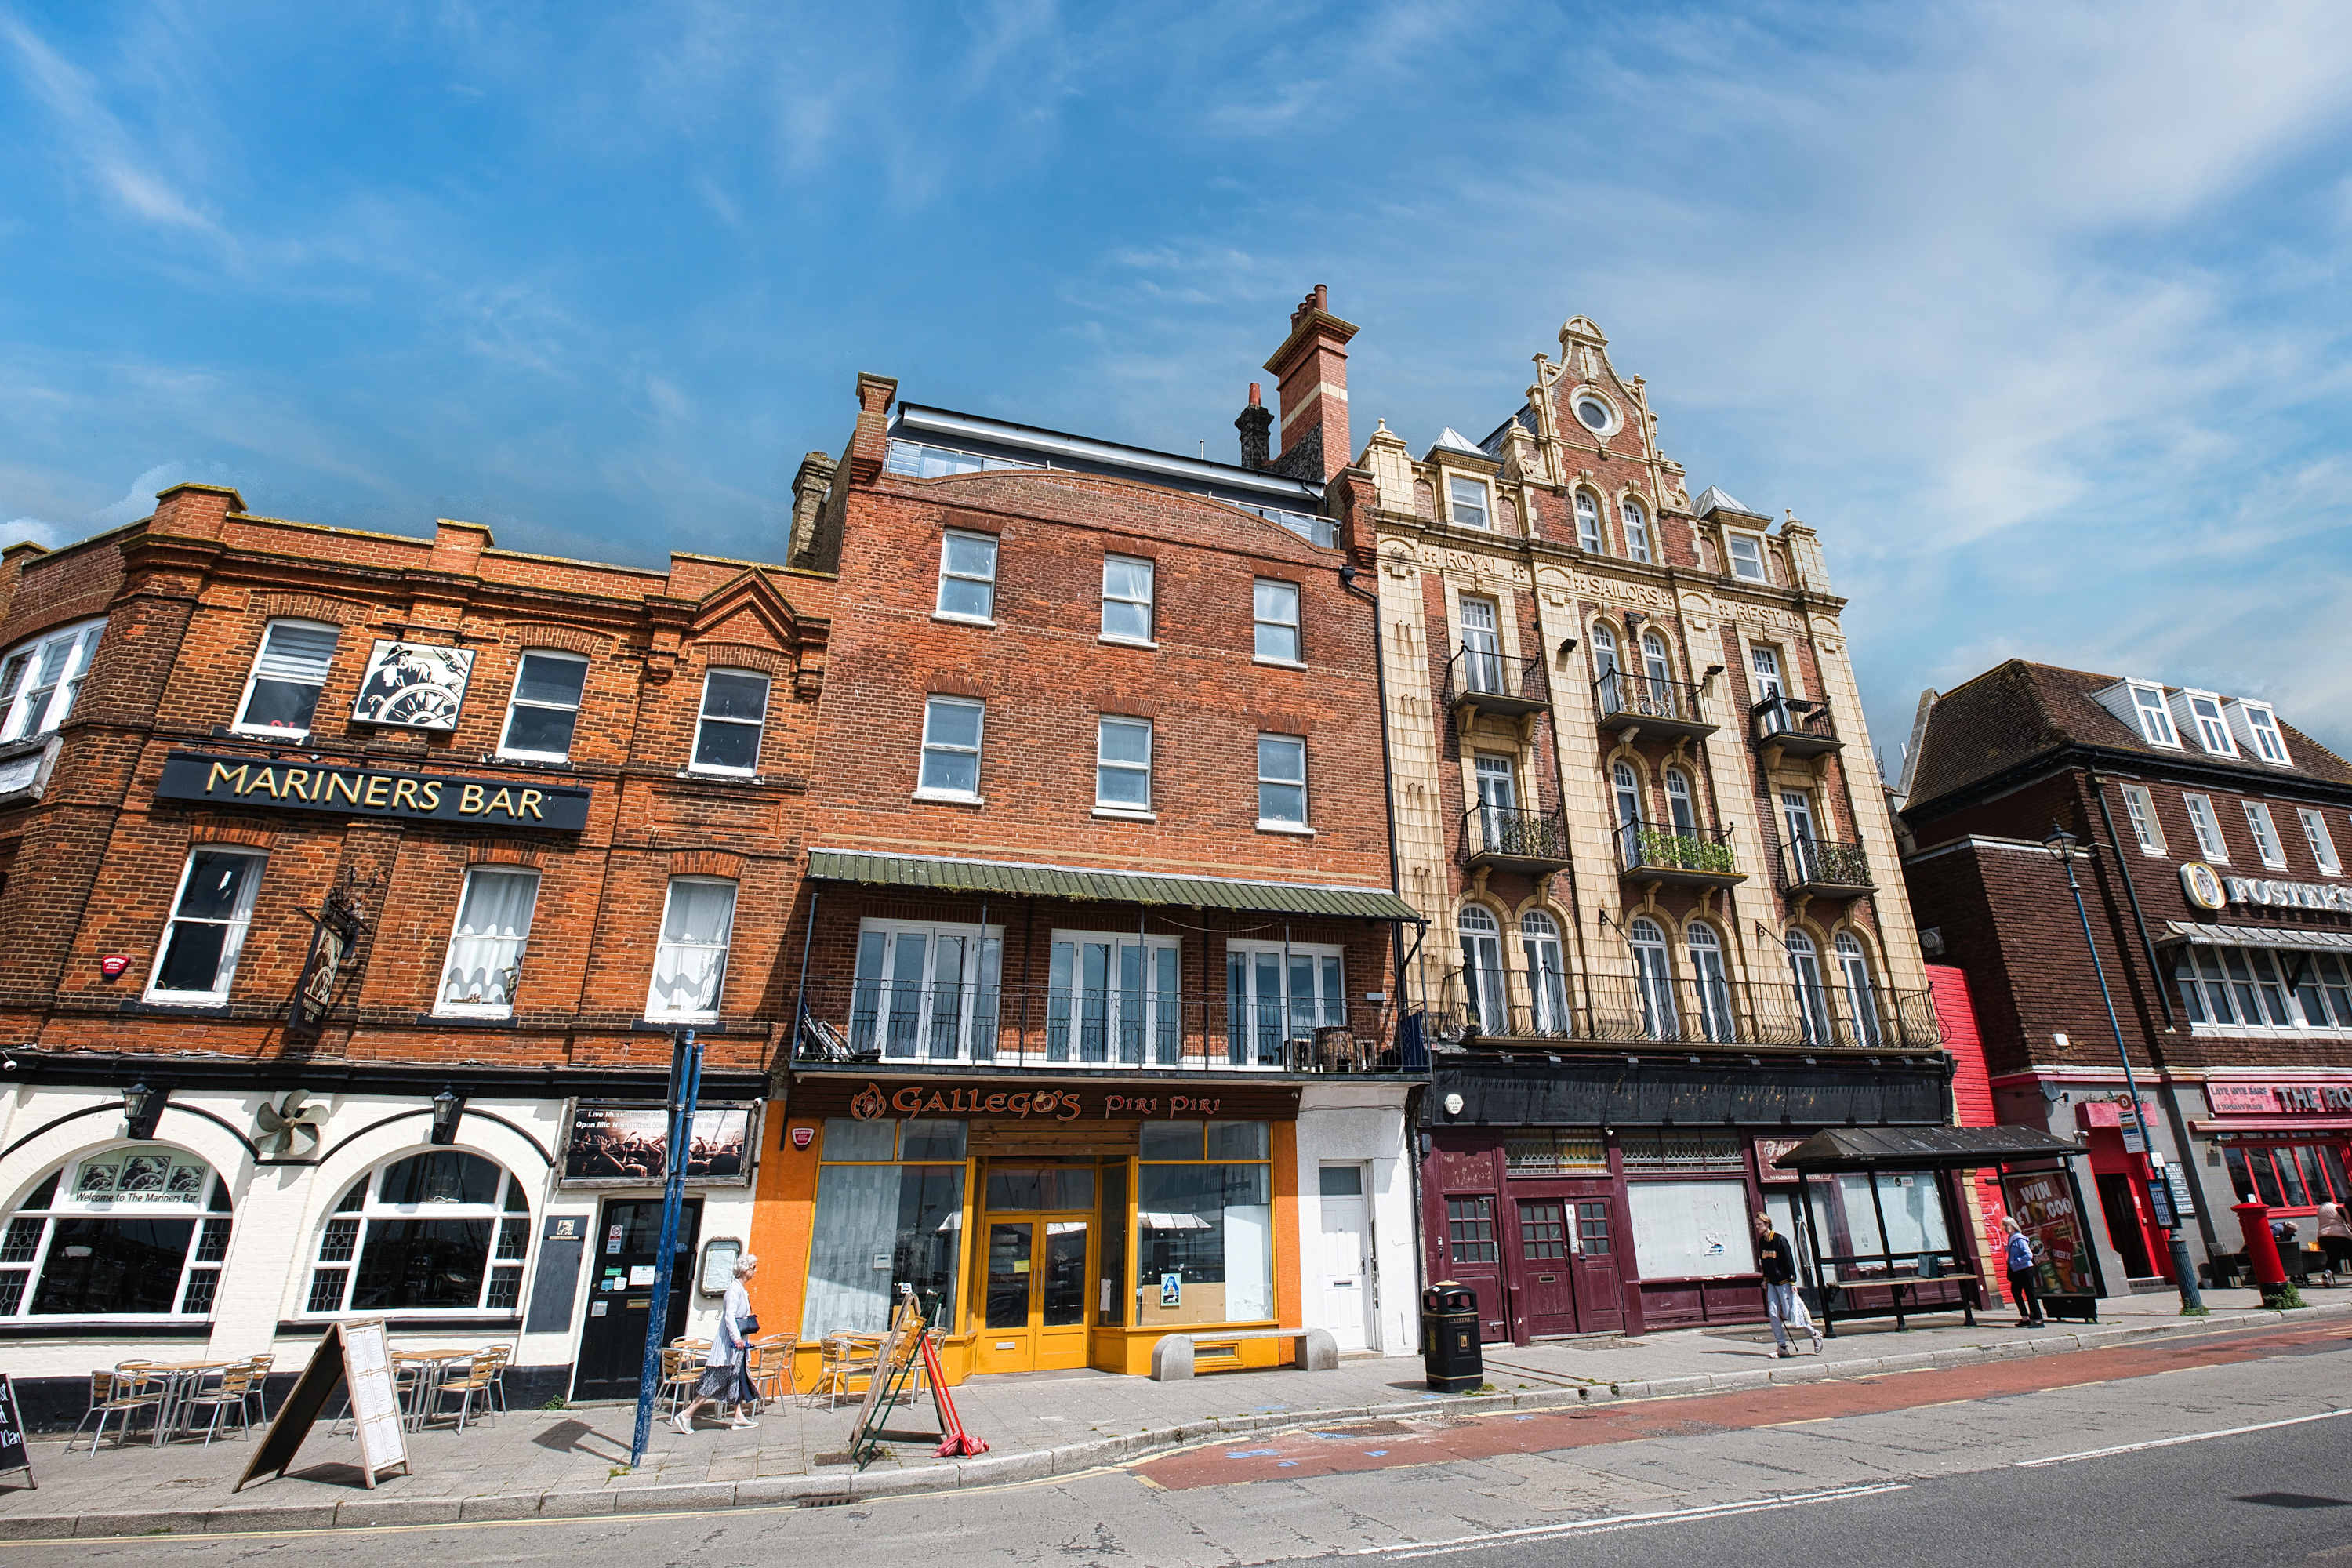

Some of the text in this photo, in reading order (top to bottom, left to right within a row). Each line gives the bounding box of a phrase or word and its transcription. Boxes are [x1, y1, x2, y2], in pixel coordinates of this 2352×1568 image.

[1446, 550, 1781, 626] ROYAL SAILORS REST
[205, 761, 543, 819] MARINERS BAR
[892, 1086, 1221, 1121] GALLEGO'S PIRI PIRI
[2274, 1086, 2322, 1111] THE
[76, 1192, 198, 1203] Welcome to The Mariners Bar
[2019, 1181, 2052, 1203] WIN
